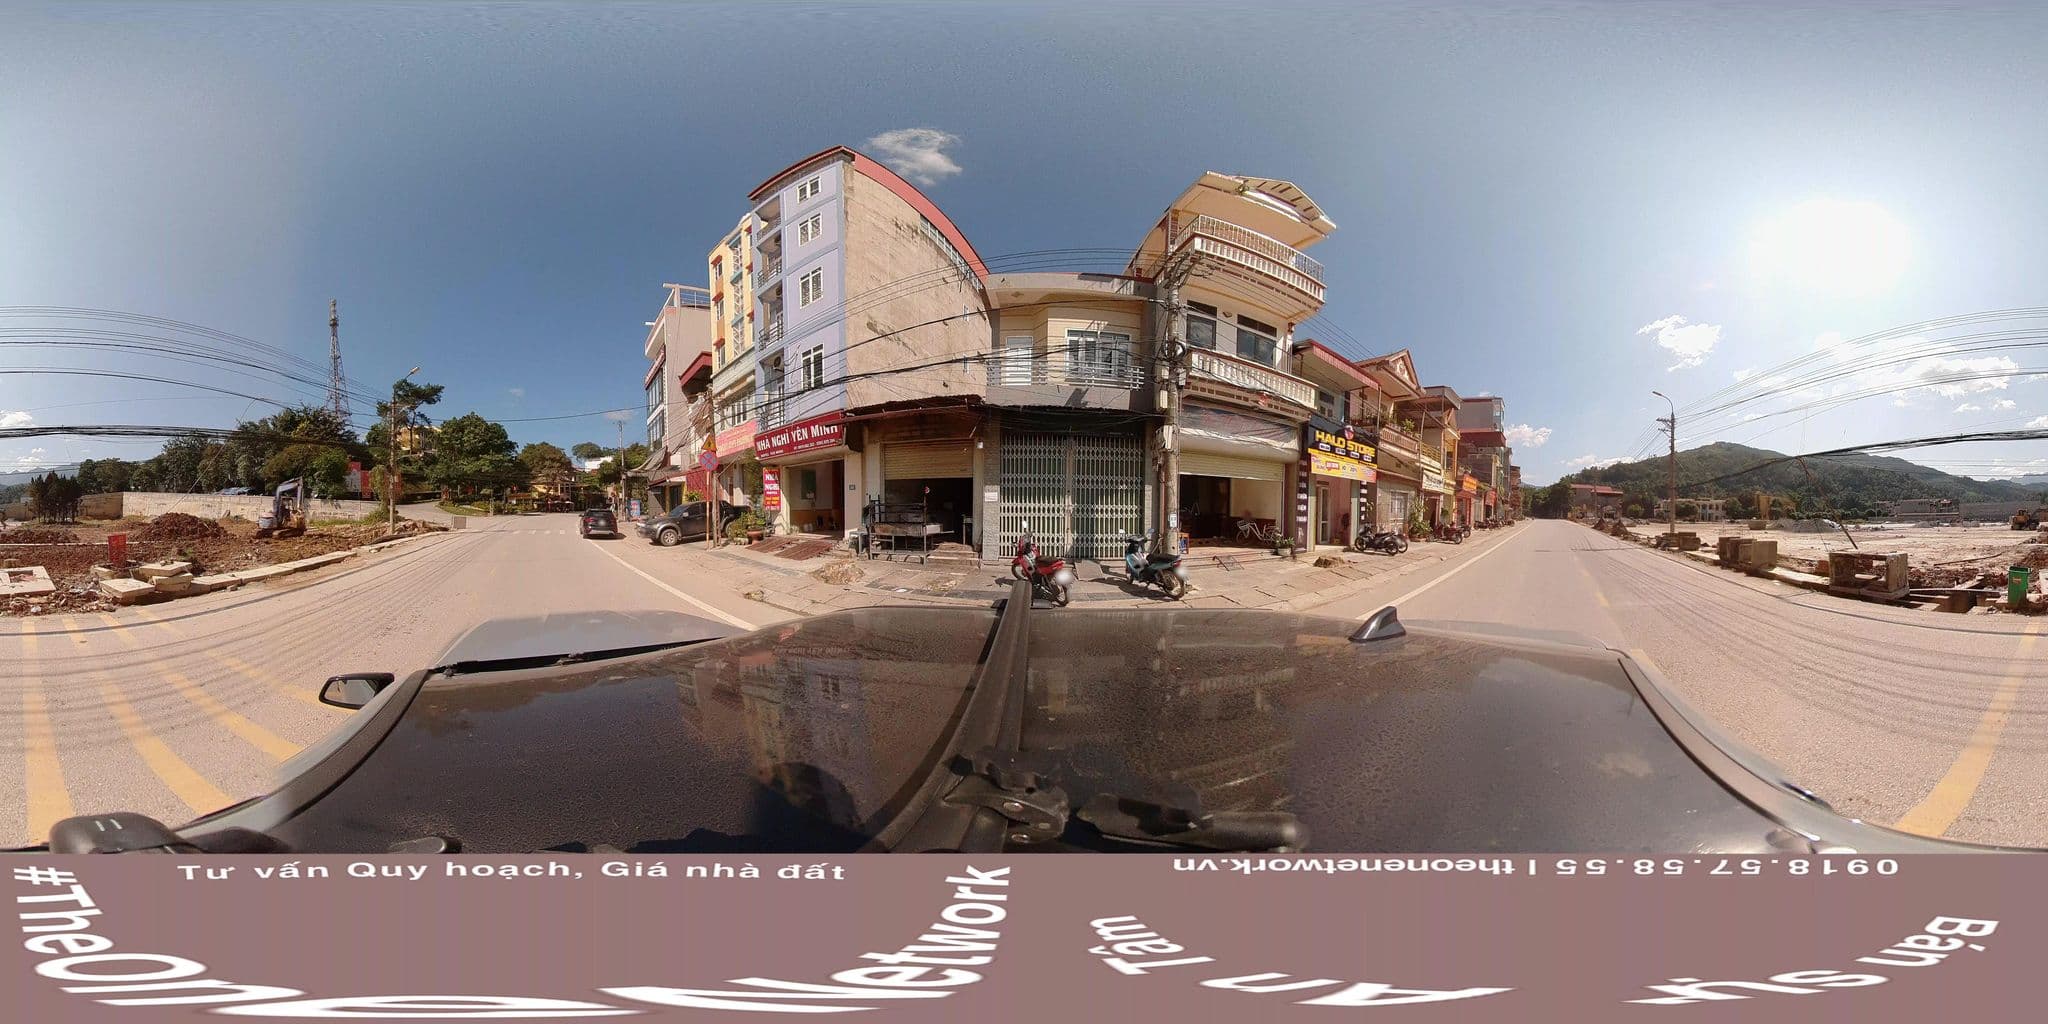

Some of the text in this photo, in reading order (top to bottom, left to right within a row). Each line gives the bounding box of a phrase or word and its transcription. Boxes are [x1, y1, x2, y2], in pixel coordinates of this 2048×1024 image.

[756, 436, 771, 451] NHÀ
[790, 426, 809, 442] YÊN
[1315, 430, 1346, 449] HALO
[1346, 440, 1376, 457] STORE
